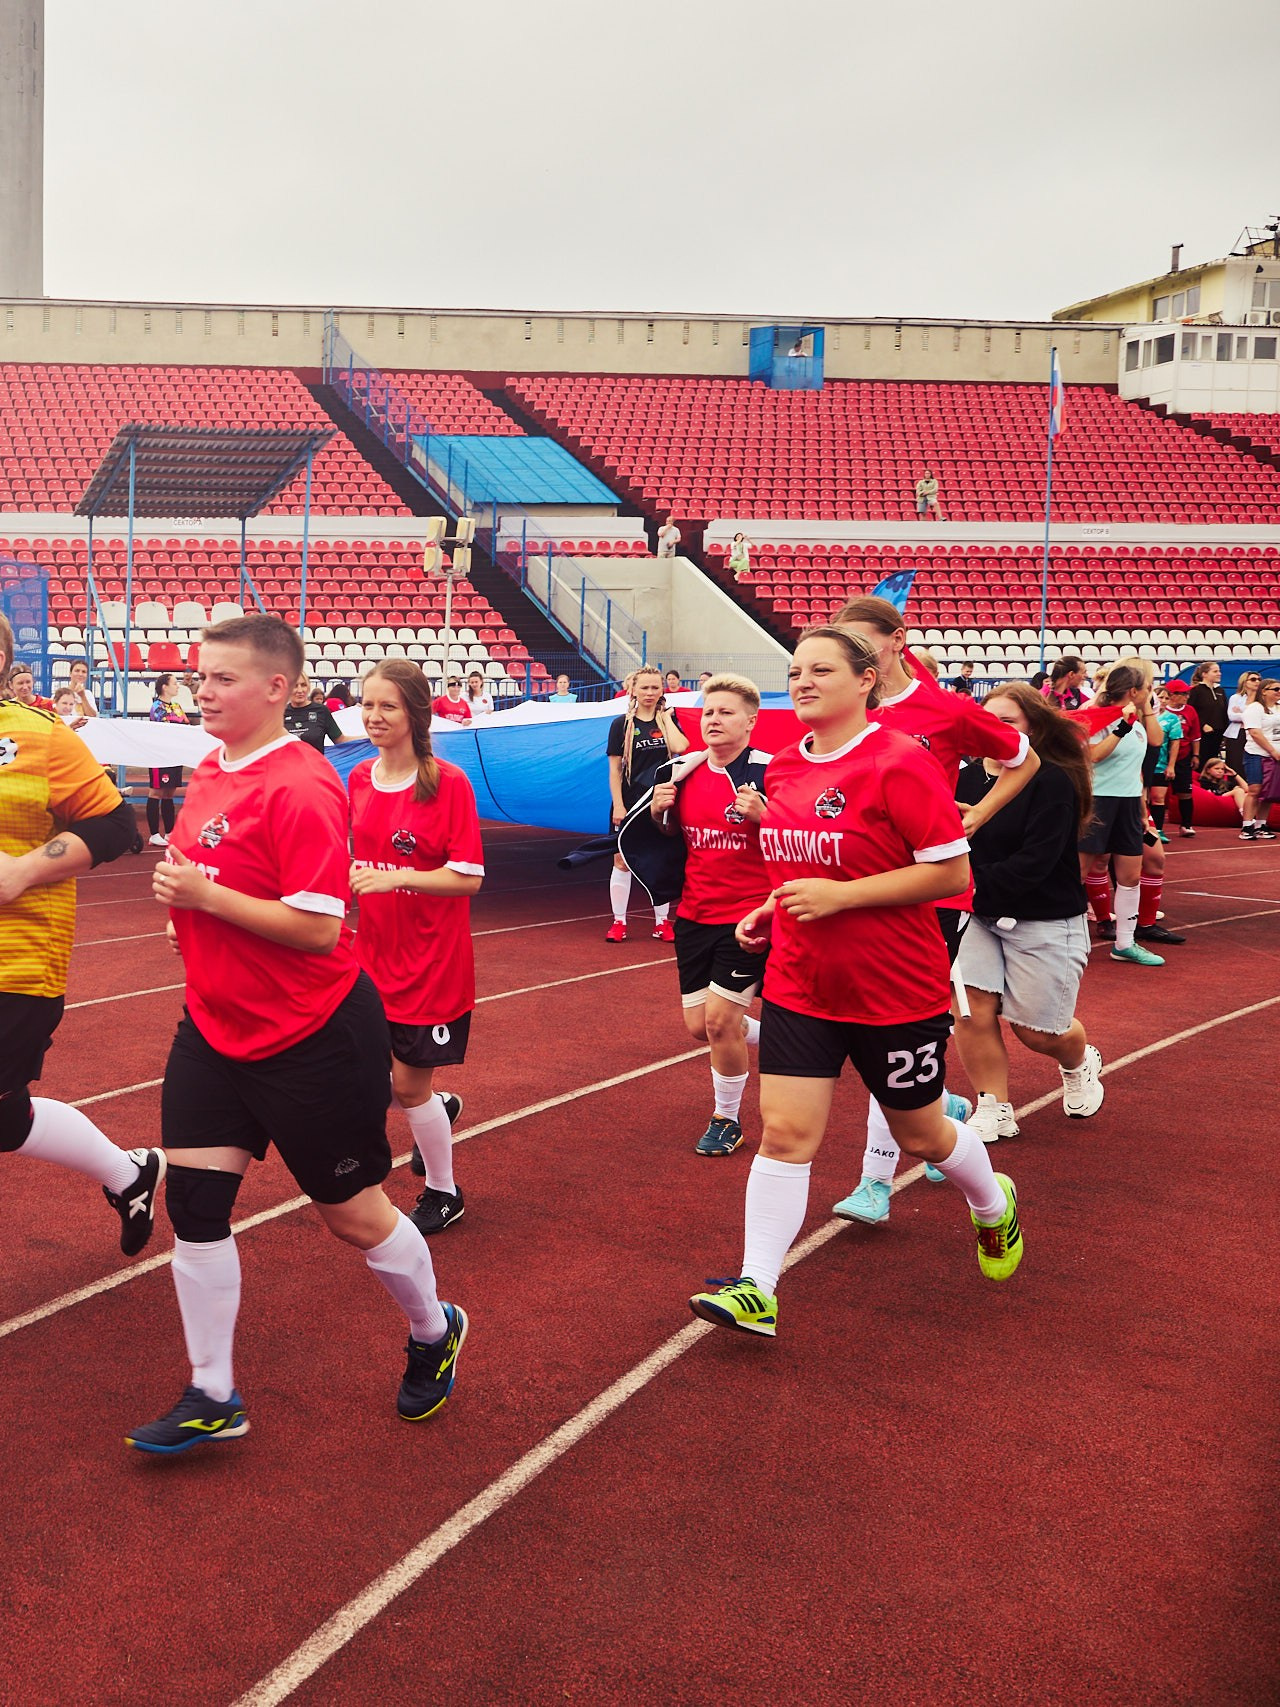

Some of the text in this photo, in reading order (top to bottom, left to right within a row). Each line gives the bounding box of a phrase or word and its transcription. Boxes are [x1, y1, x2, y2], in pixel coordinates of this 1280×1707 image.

[635, 737, 665, 749] ATLET
[759, 827, 844, 867] ЕТАЛЛИСТ
[886, 1041, 939, 1090] 23
[870, 1147, 895, 1159] JAKO
